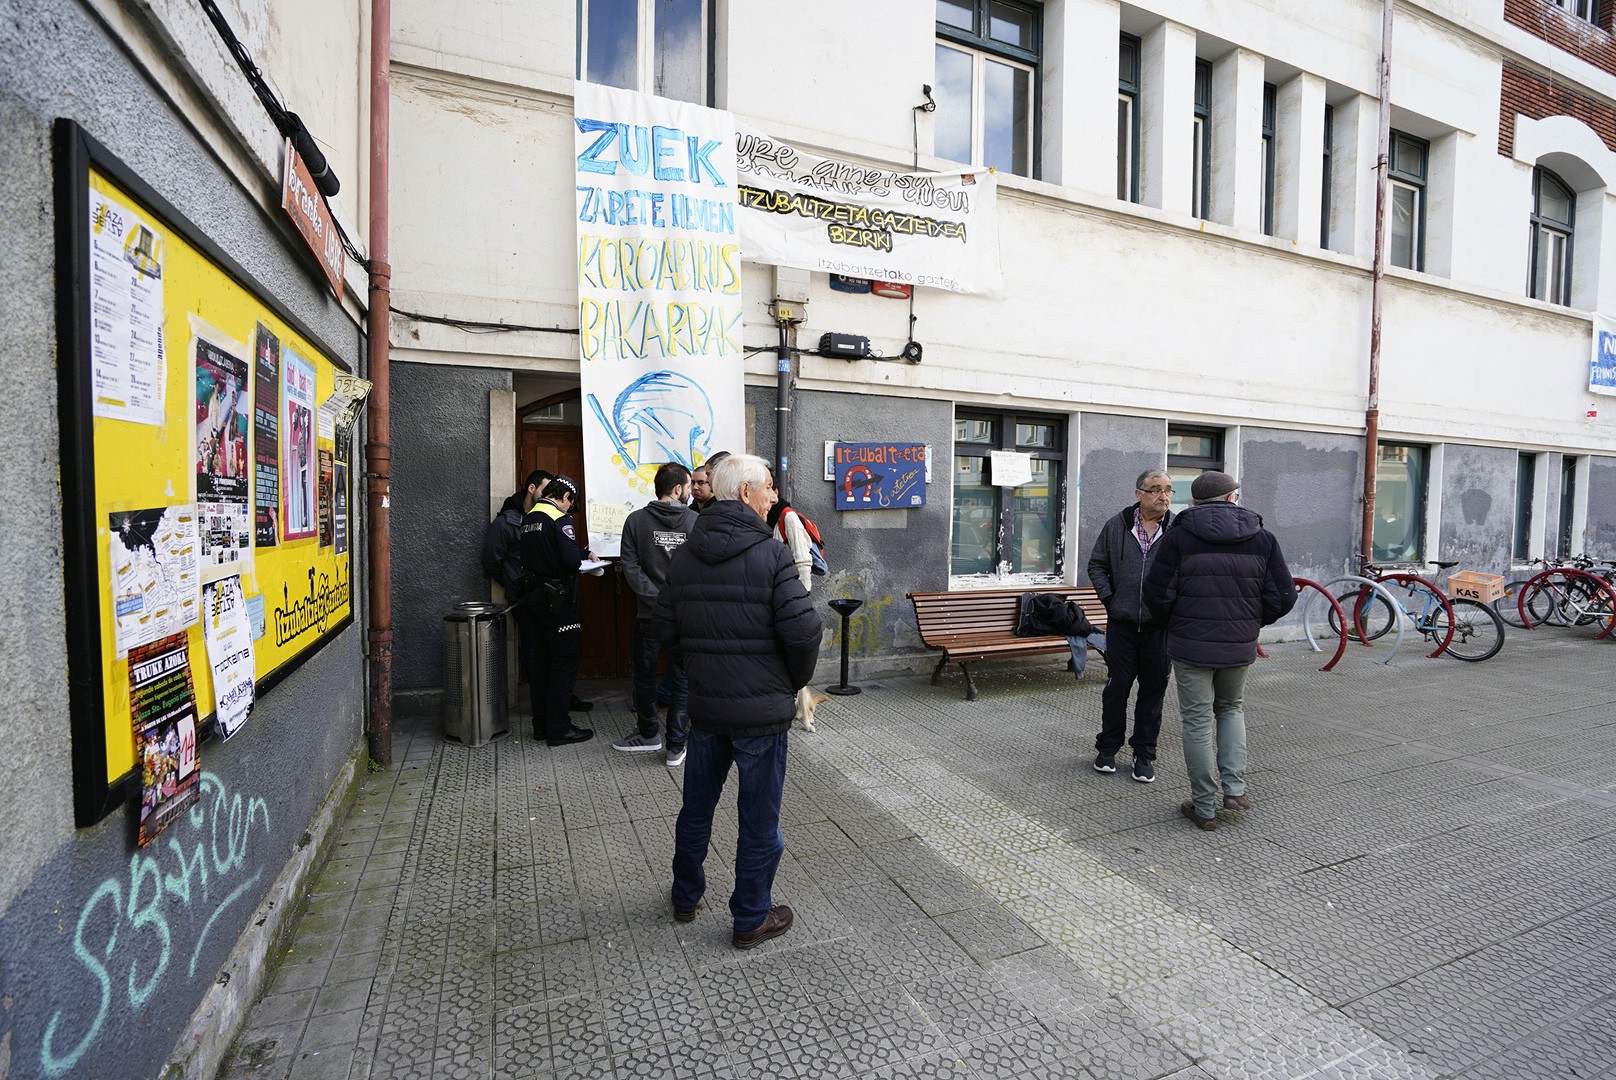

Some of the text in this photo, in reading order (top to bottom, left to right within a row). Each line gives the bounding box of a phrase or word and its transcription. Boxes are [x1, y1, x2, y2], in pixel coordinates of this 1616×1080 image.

[574, 117, 727, 187] ZUEK
[576, 186, 735, 234] ZARETE HEMEN
[579, 234, 741, 295] KOROABIRUS
[580, 298, 743, 361] BAKARRAK
[836, 445, 926, 464] Itzubaltzeta
[1456, 588, 1480, 599] KAS
[133, 651, 187, 683] TRUKE AZOKA
